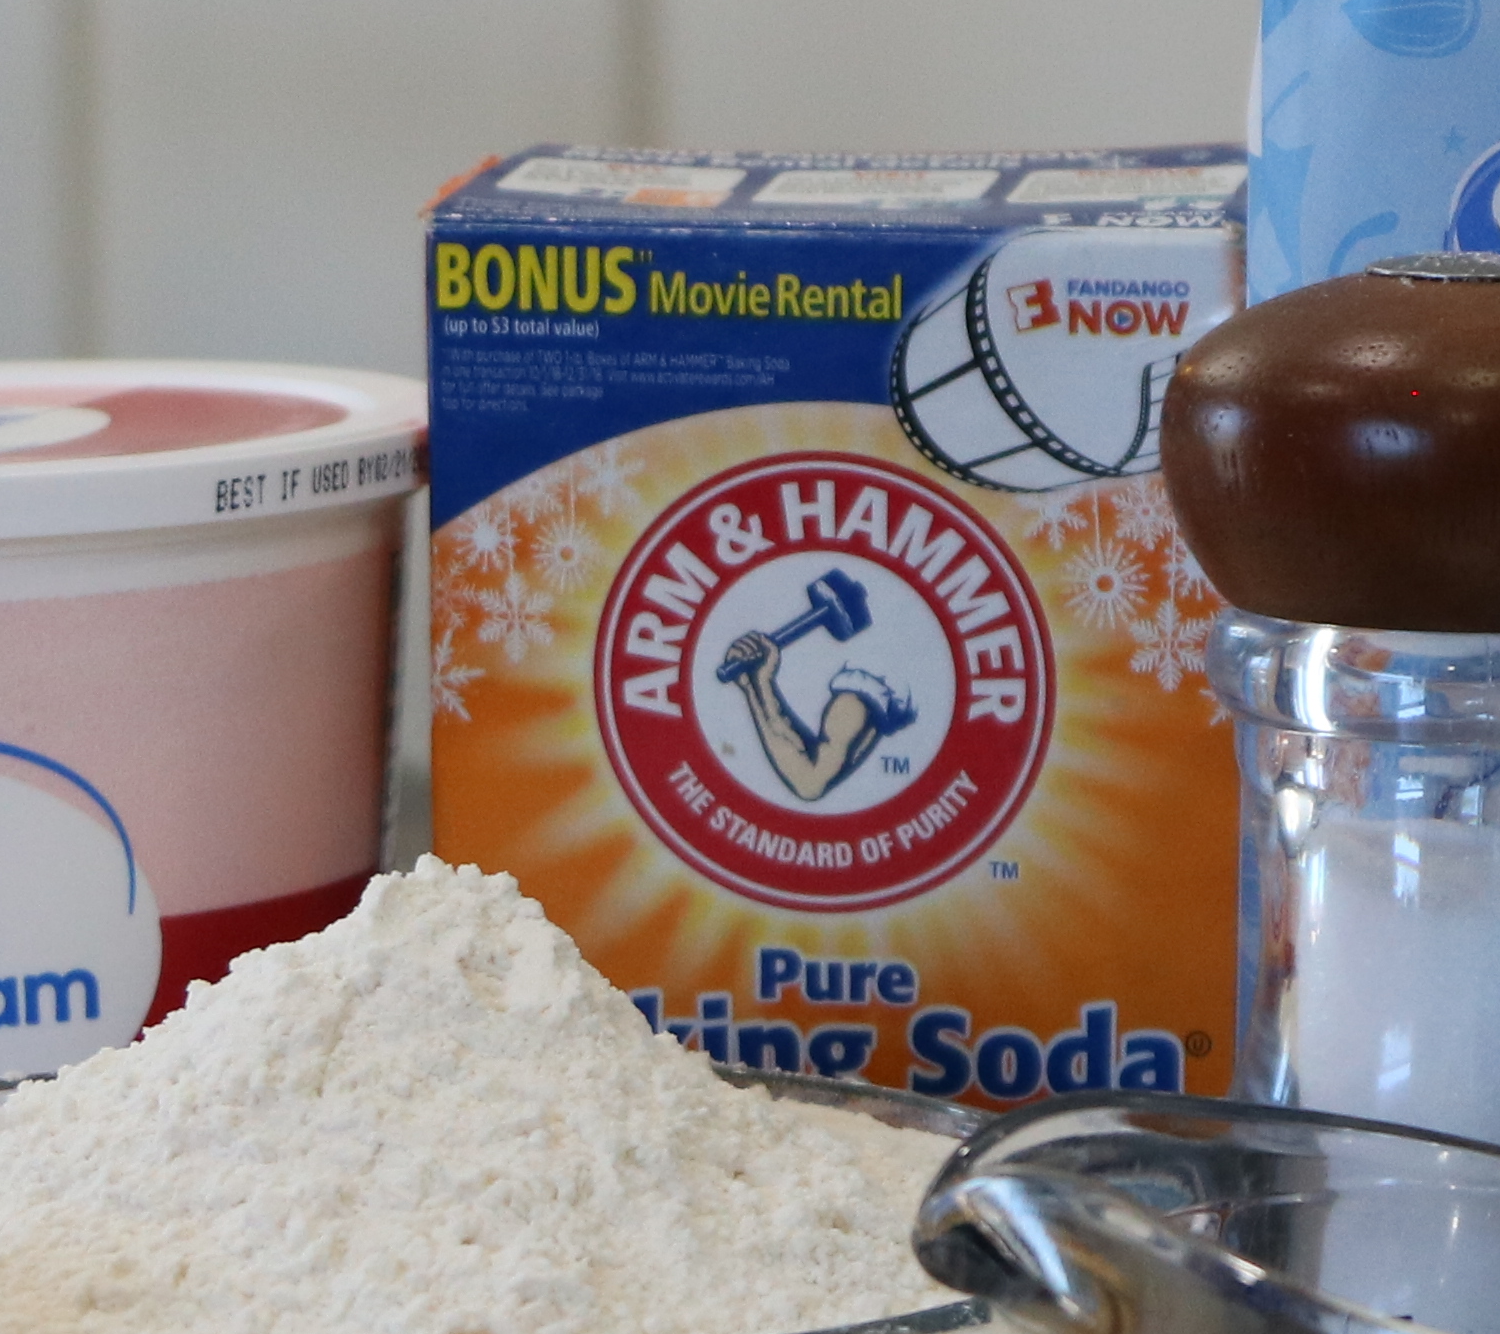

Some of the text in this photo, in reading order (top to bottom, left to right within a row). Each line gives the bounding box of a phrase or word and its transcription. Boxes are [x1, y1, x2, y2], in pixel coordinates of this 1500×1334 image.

[650, 271, 770, 316] Movie
[777, 273, 903, 321] Rental
[1067, 280, 1190, 297] FANDANGO
[473, 318, 488, 334] to
[514, 318, 550, 336] total
[554, 319, 600, 339] value)
[1068, 300, 1190, 336] NOW
[216, 474, 267, 513] BEST
[282, 469, 301, 501] IF
[313, 459, 349, 494] USED
[624, 480, 1026, 724] ARM & HAMMER
[669, 762, 979, 867] THE STANDARD OF PURITY
[757, 947, 917, 1003] Pure
[632, 993, 1184, 1099] king Soda
